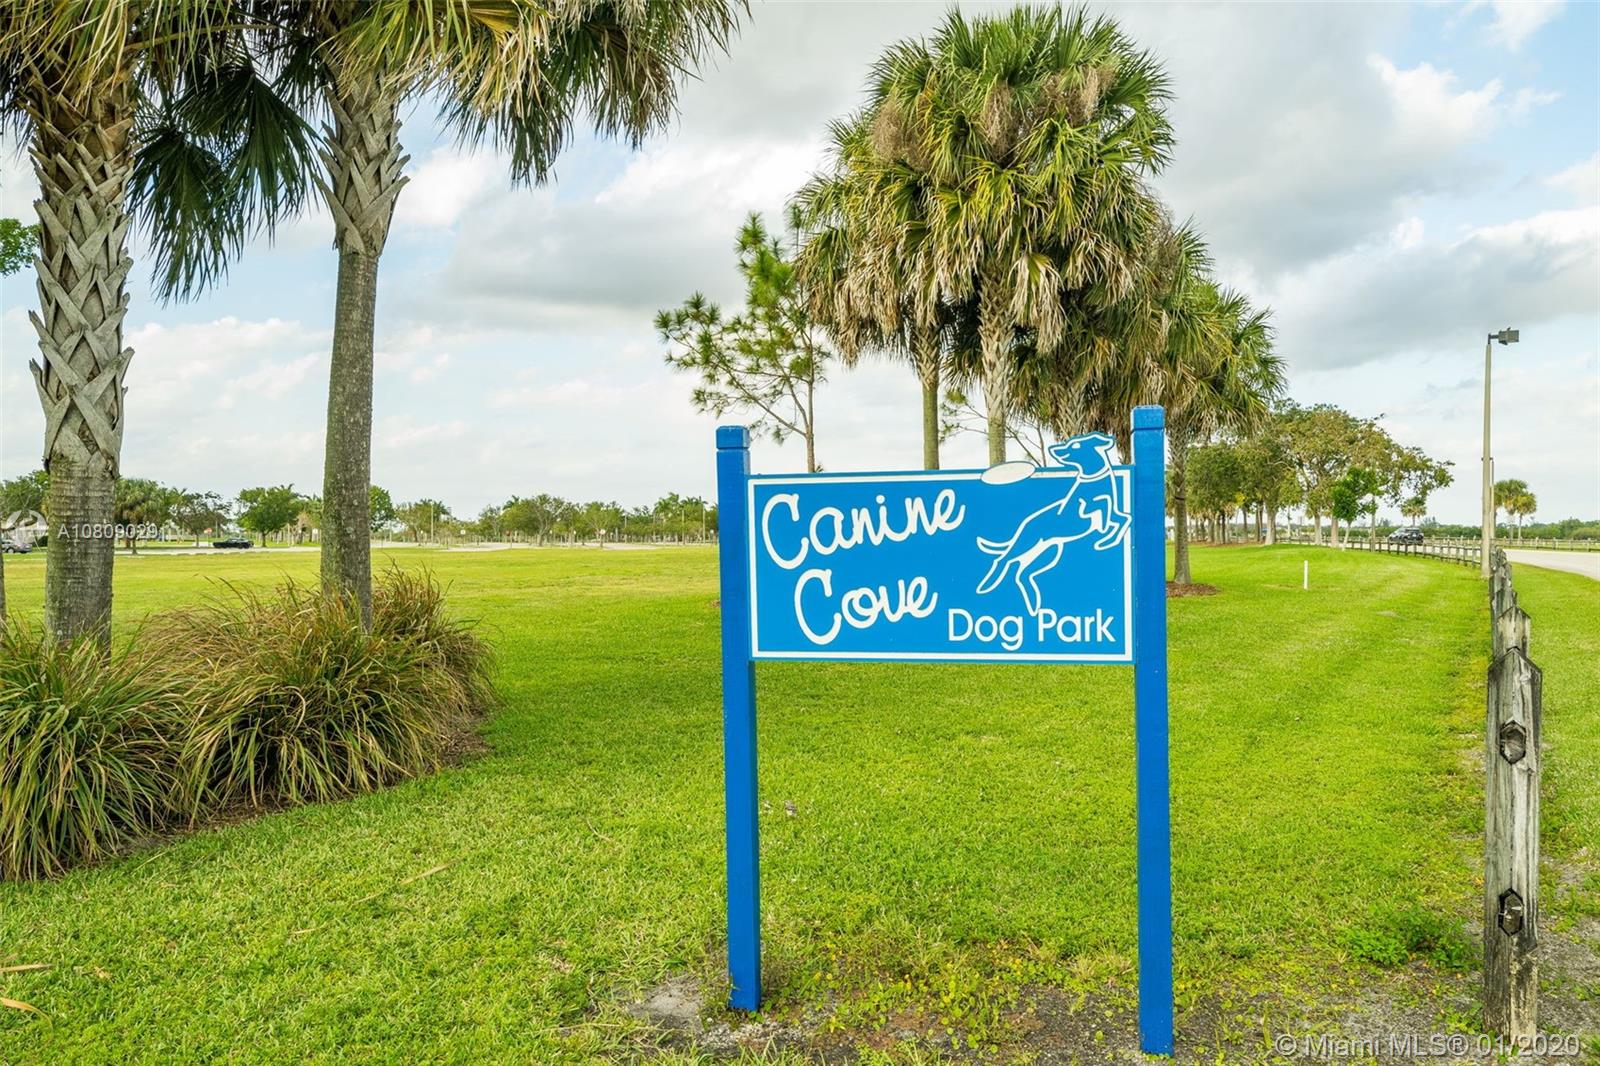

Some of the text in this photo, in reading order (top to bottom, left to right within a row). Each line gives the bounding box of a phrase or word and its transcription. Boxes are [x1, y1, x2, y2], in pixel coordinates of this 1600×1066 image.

[762, 488, 966, 570] Canine
[794, 569, 938, 645] Cove
[948, 608, 1116, 651] Dog Park
